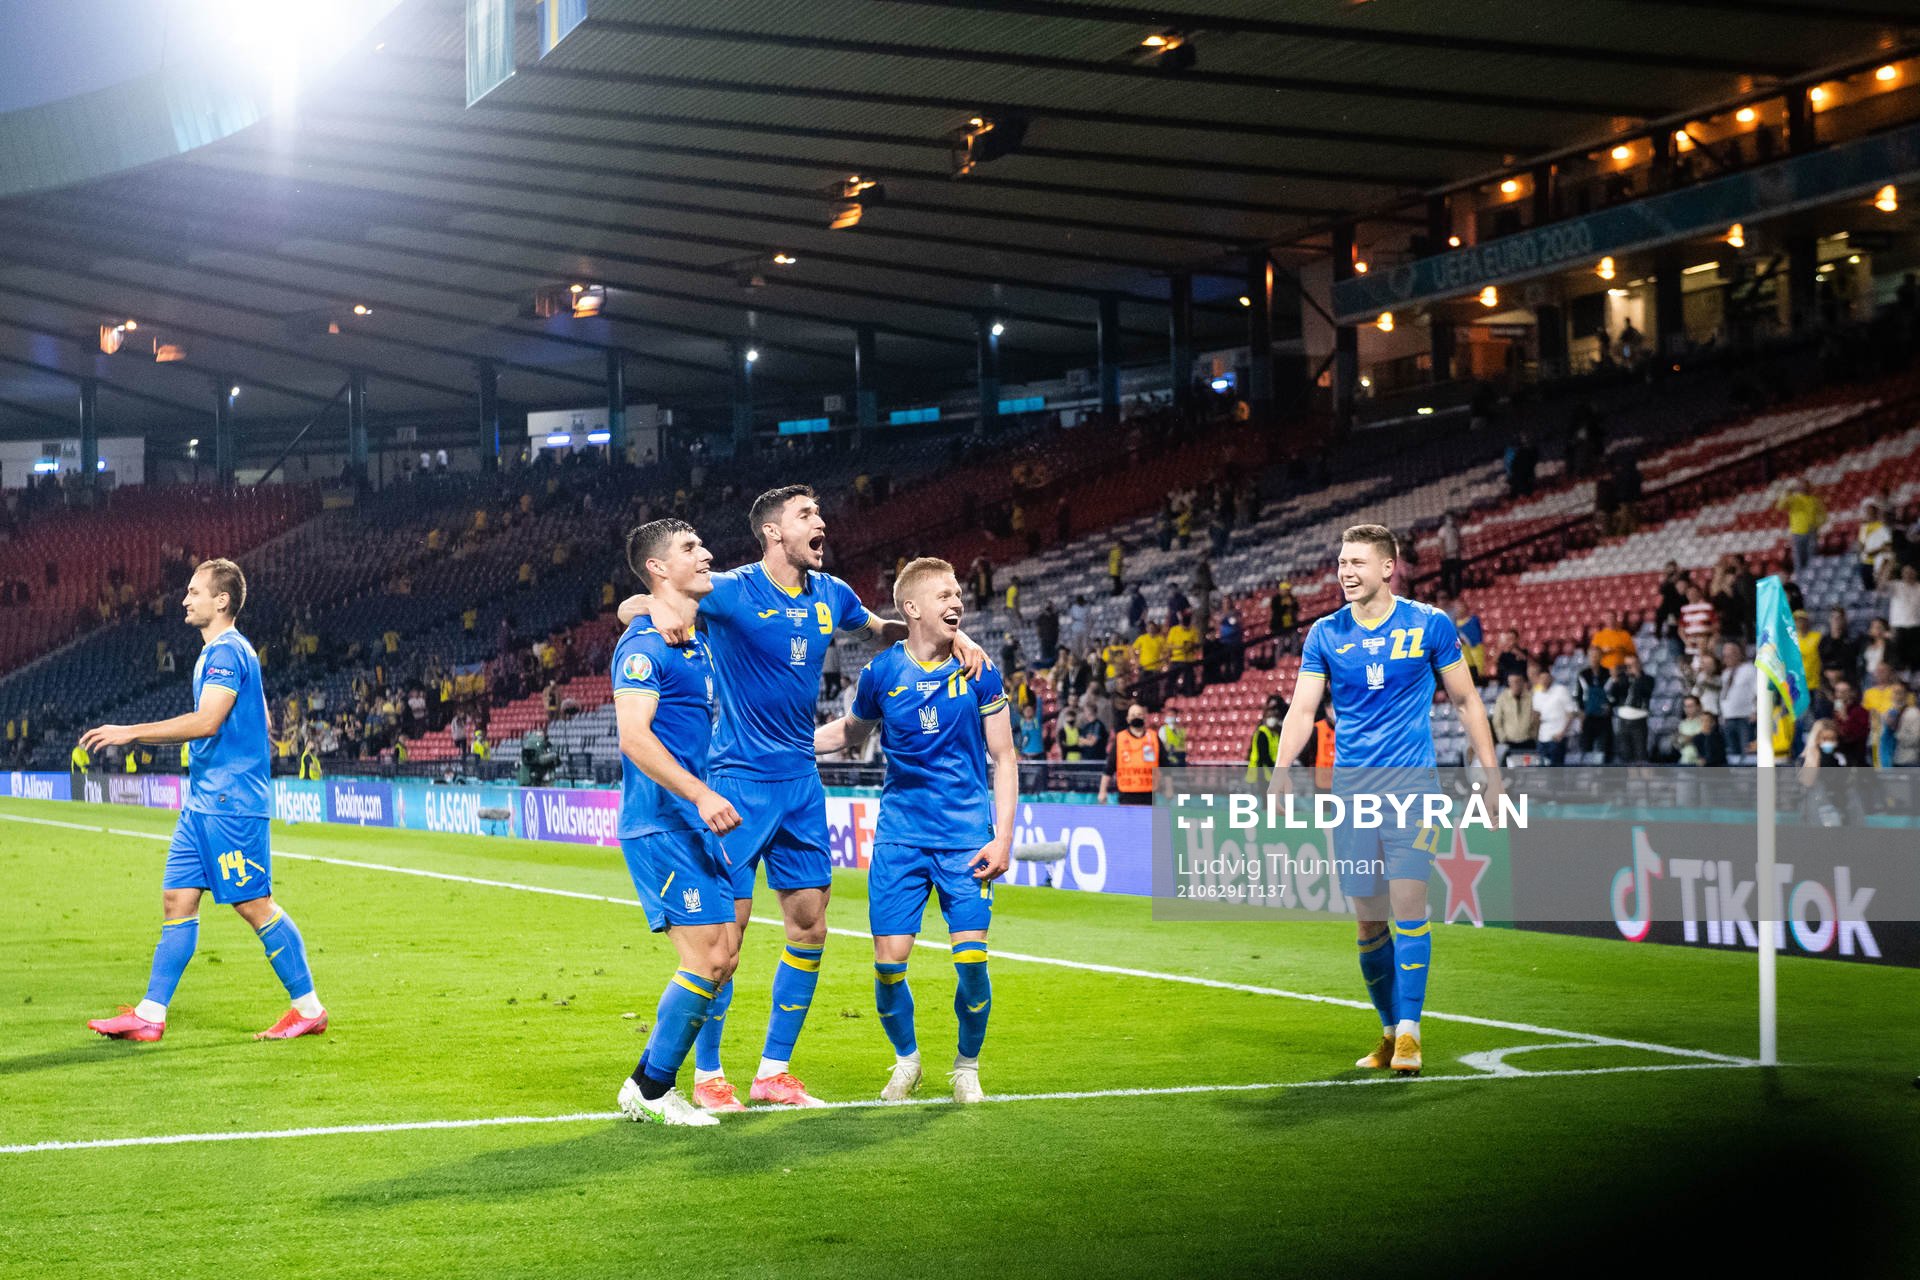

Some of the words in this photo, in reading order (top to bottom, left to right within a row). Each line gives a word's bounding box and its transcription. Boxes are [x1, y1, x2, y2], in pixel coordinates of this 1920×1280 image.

[1432, 250, 1484, 289] UEFA
[1484, 237, 1537, 279] EURO
[1538, 220, 1593, 265] 2020
[815, 602, 833, 634] 9
[1390, 627, 1424, 660] 22
[948, 669, 967, 698] 11
[274, 780, 321, 823] Hisense
[335, 785, 382, 826] Booking.com
[425, 790, 483, 836] GLASGOW
[542, 794, 617, 846] Volkswagen
[828, 803, 875, 869] edE
[218, 850, 246, 880] 14
